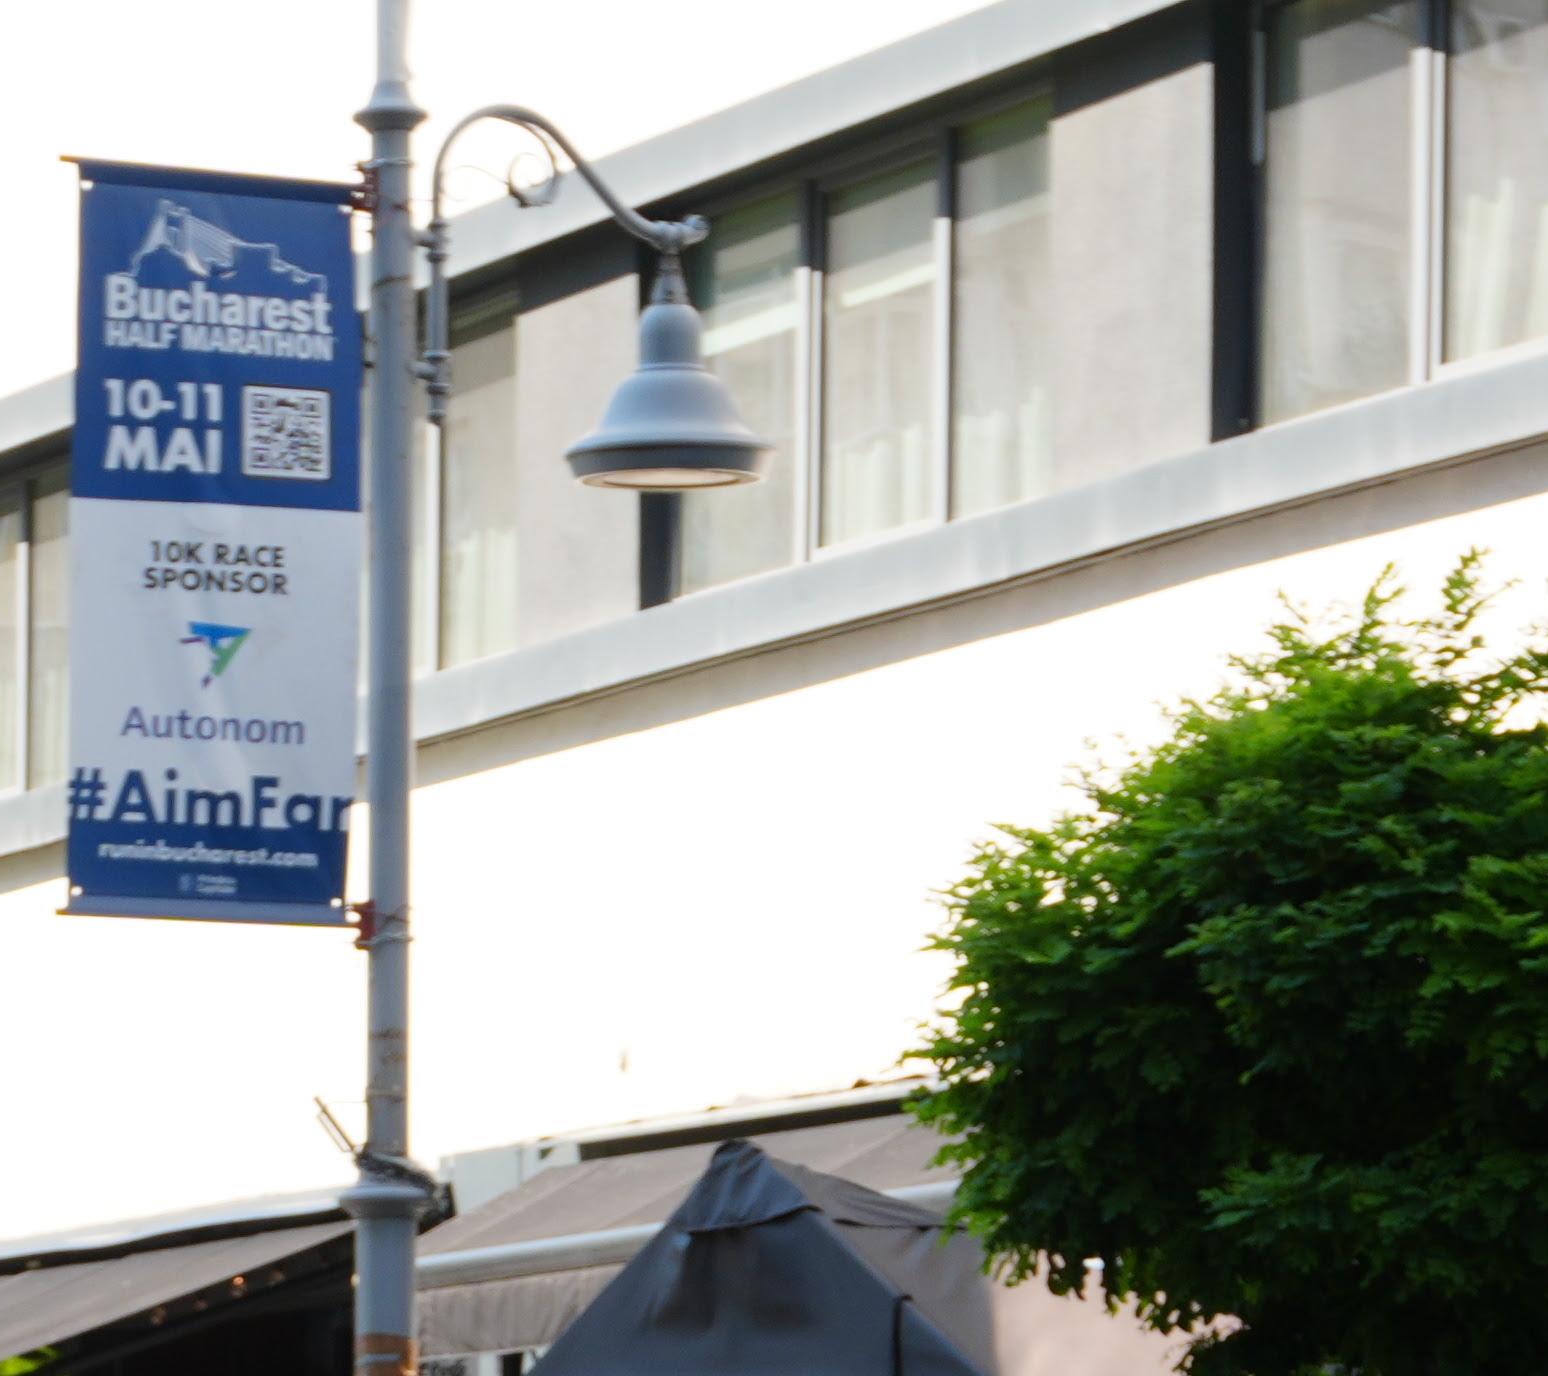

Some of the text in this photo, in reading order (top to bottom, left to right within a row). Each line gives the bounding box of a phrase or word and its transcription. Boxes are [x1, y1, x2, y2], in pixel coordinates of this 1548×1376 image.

[104, 275, 334, 334] Bucharest
[104, 319, 335, 362] HALF MARATHON
[103, 378, 223, 423] 10-11
[103, 424, 223, 475] MAI
[150, 540, 286, 569] 10K RACE
[143, 567, 288, 596] SPONSOR
[120, 706, 306, 745] Autonom
[67, 766, 354, 832] #AimFar
